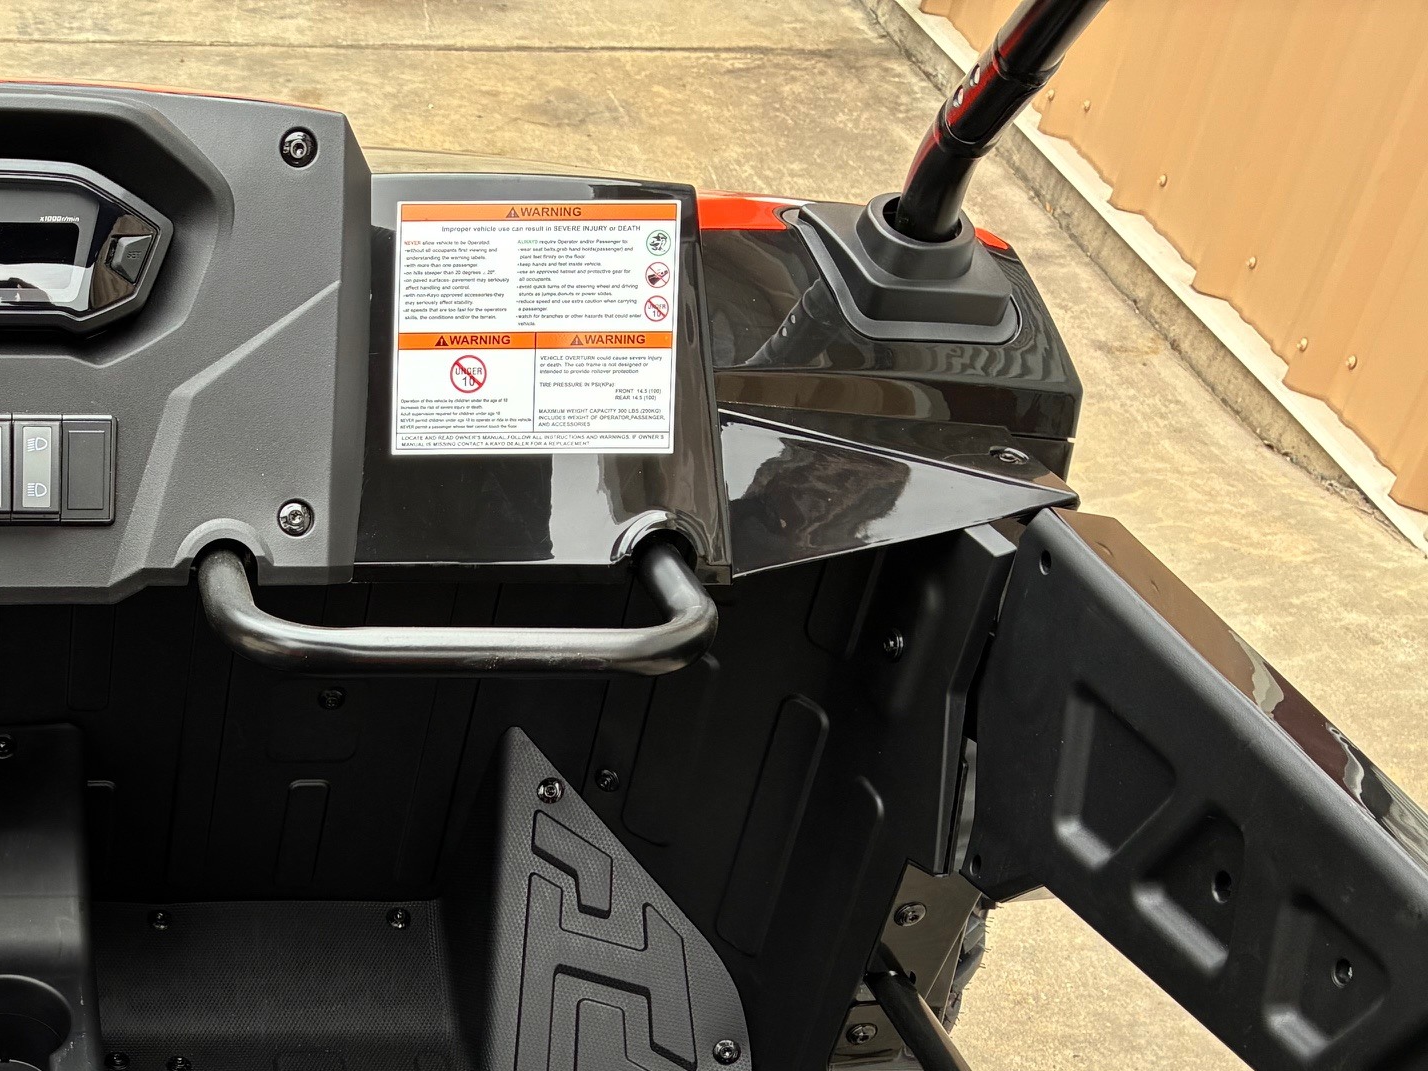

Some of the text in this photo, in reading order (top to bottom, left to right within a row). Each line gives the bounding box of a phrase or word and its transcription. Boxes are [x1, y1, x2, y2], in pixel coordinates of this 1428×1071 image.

[520, 207, 582, 217] WARNING
[126, 250, 143, 259] SET
[449, 335, 511, 345] WARNING
[584, 334, 646, 344] WARNING
